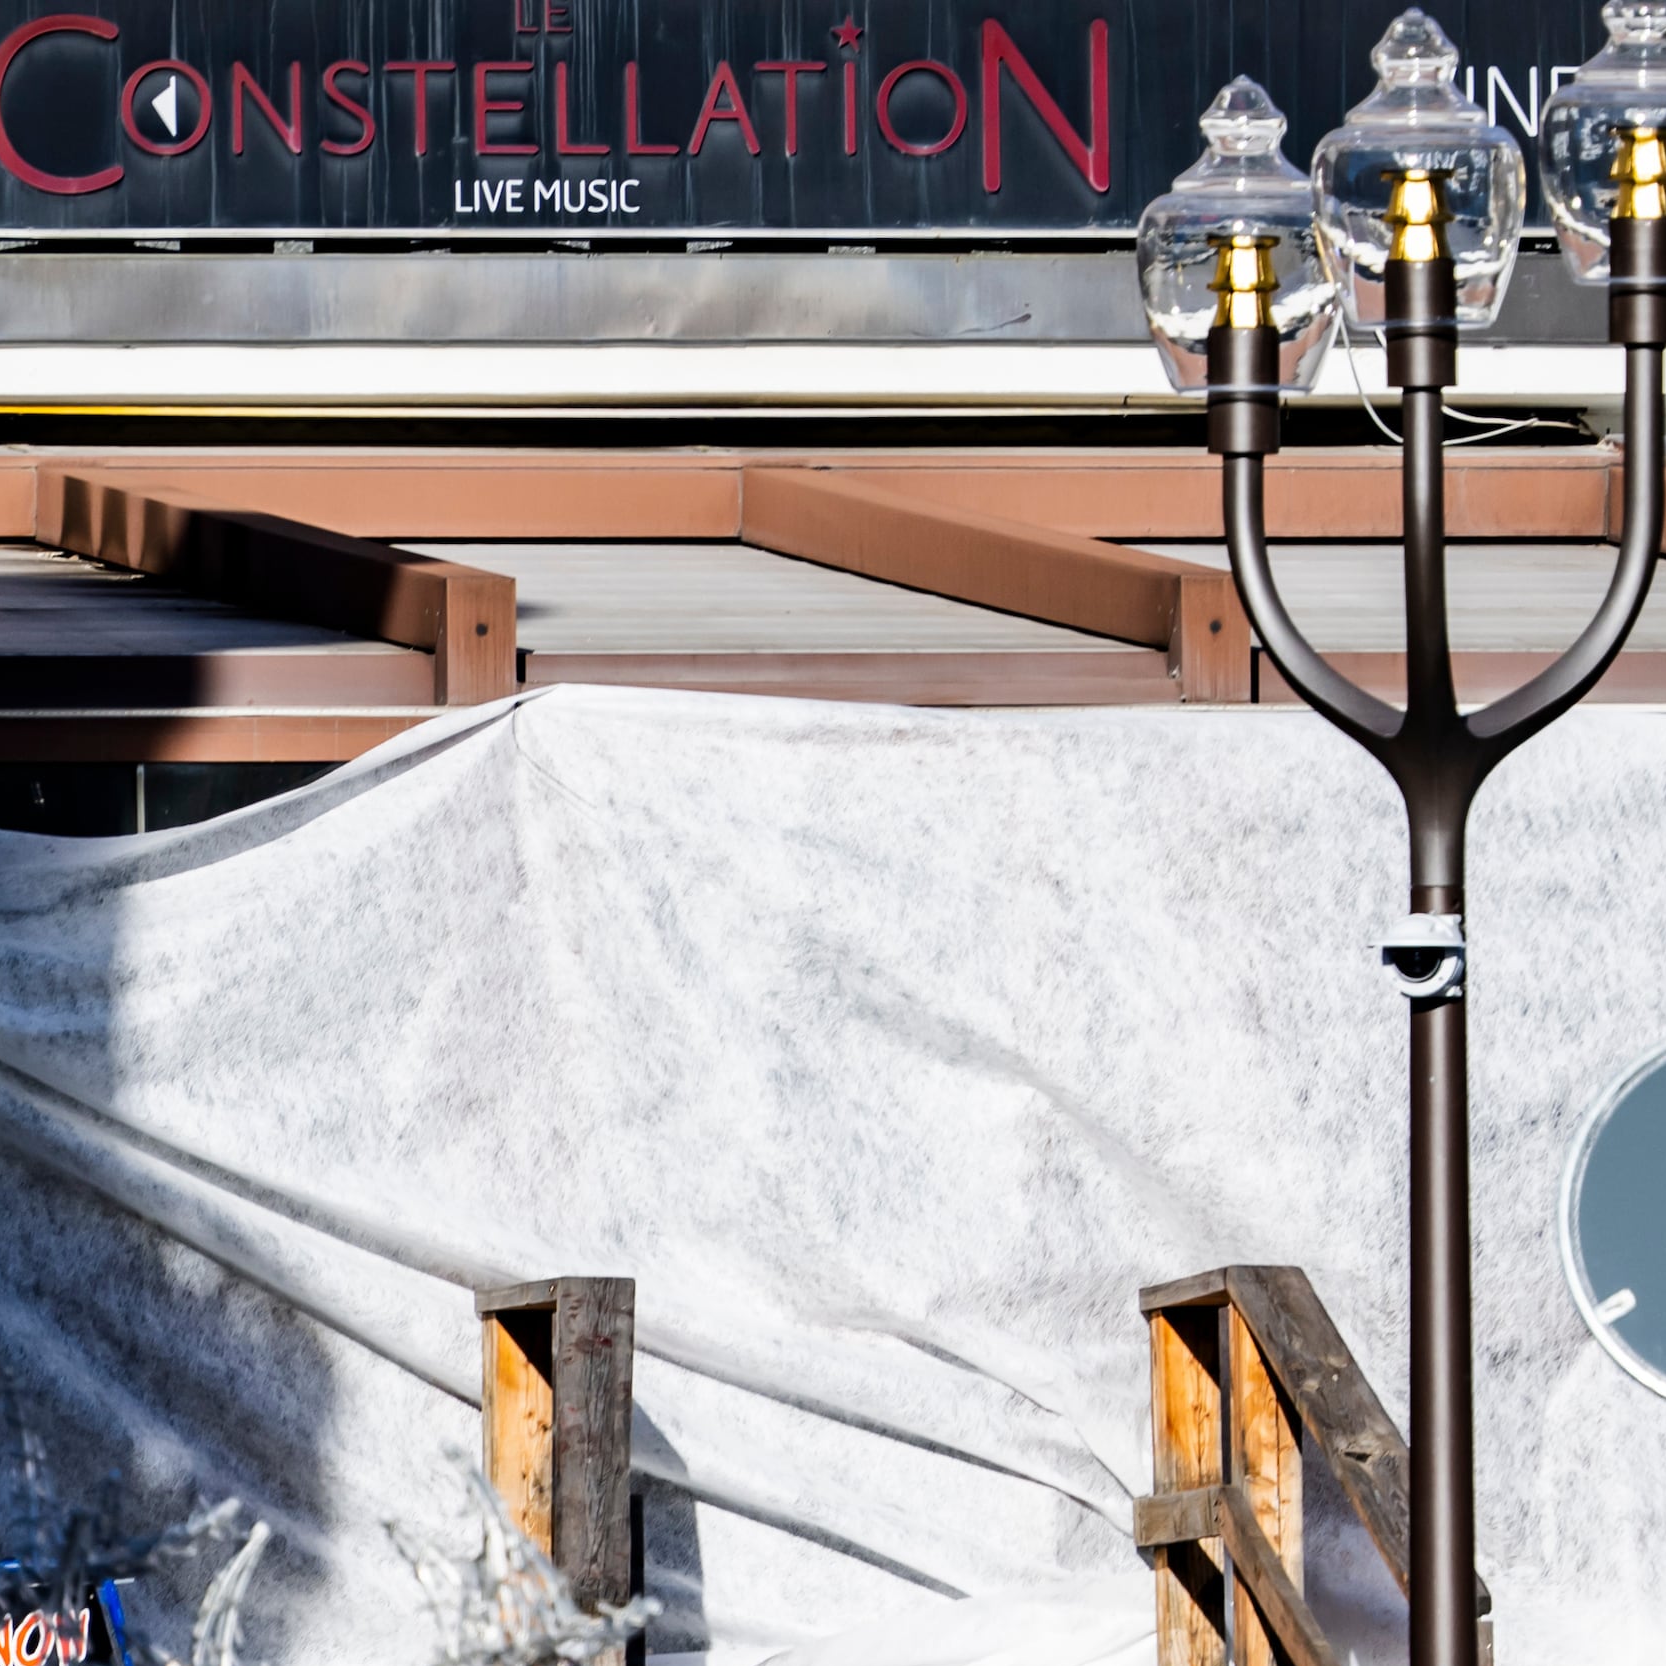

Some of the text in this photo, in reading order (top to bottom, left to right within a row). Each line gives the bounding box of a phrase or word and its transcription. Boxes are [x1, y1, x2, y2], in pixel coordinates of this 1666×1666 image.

[515, 0, 573, 33] LE
[454, 178, 641, 214] LIVE MUSIC
